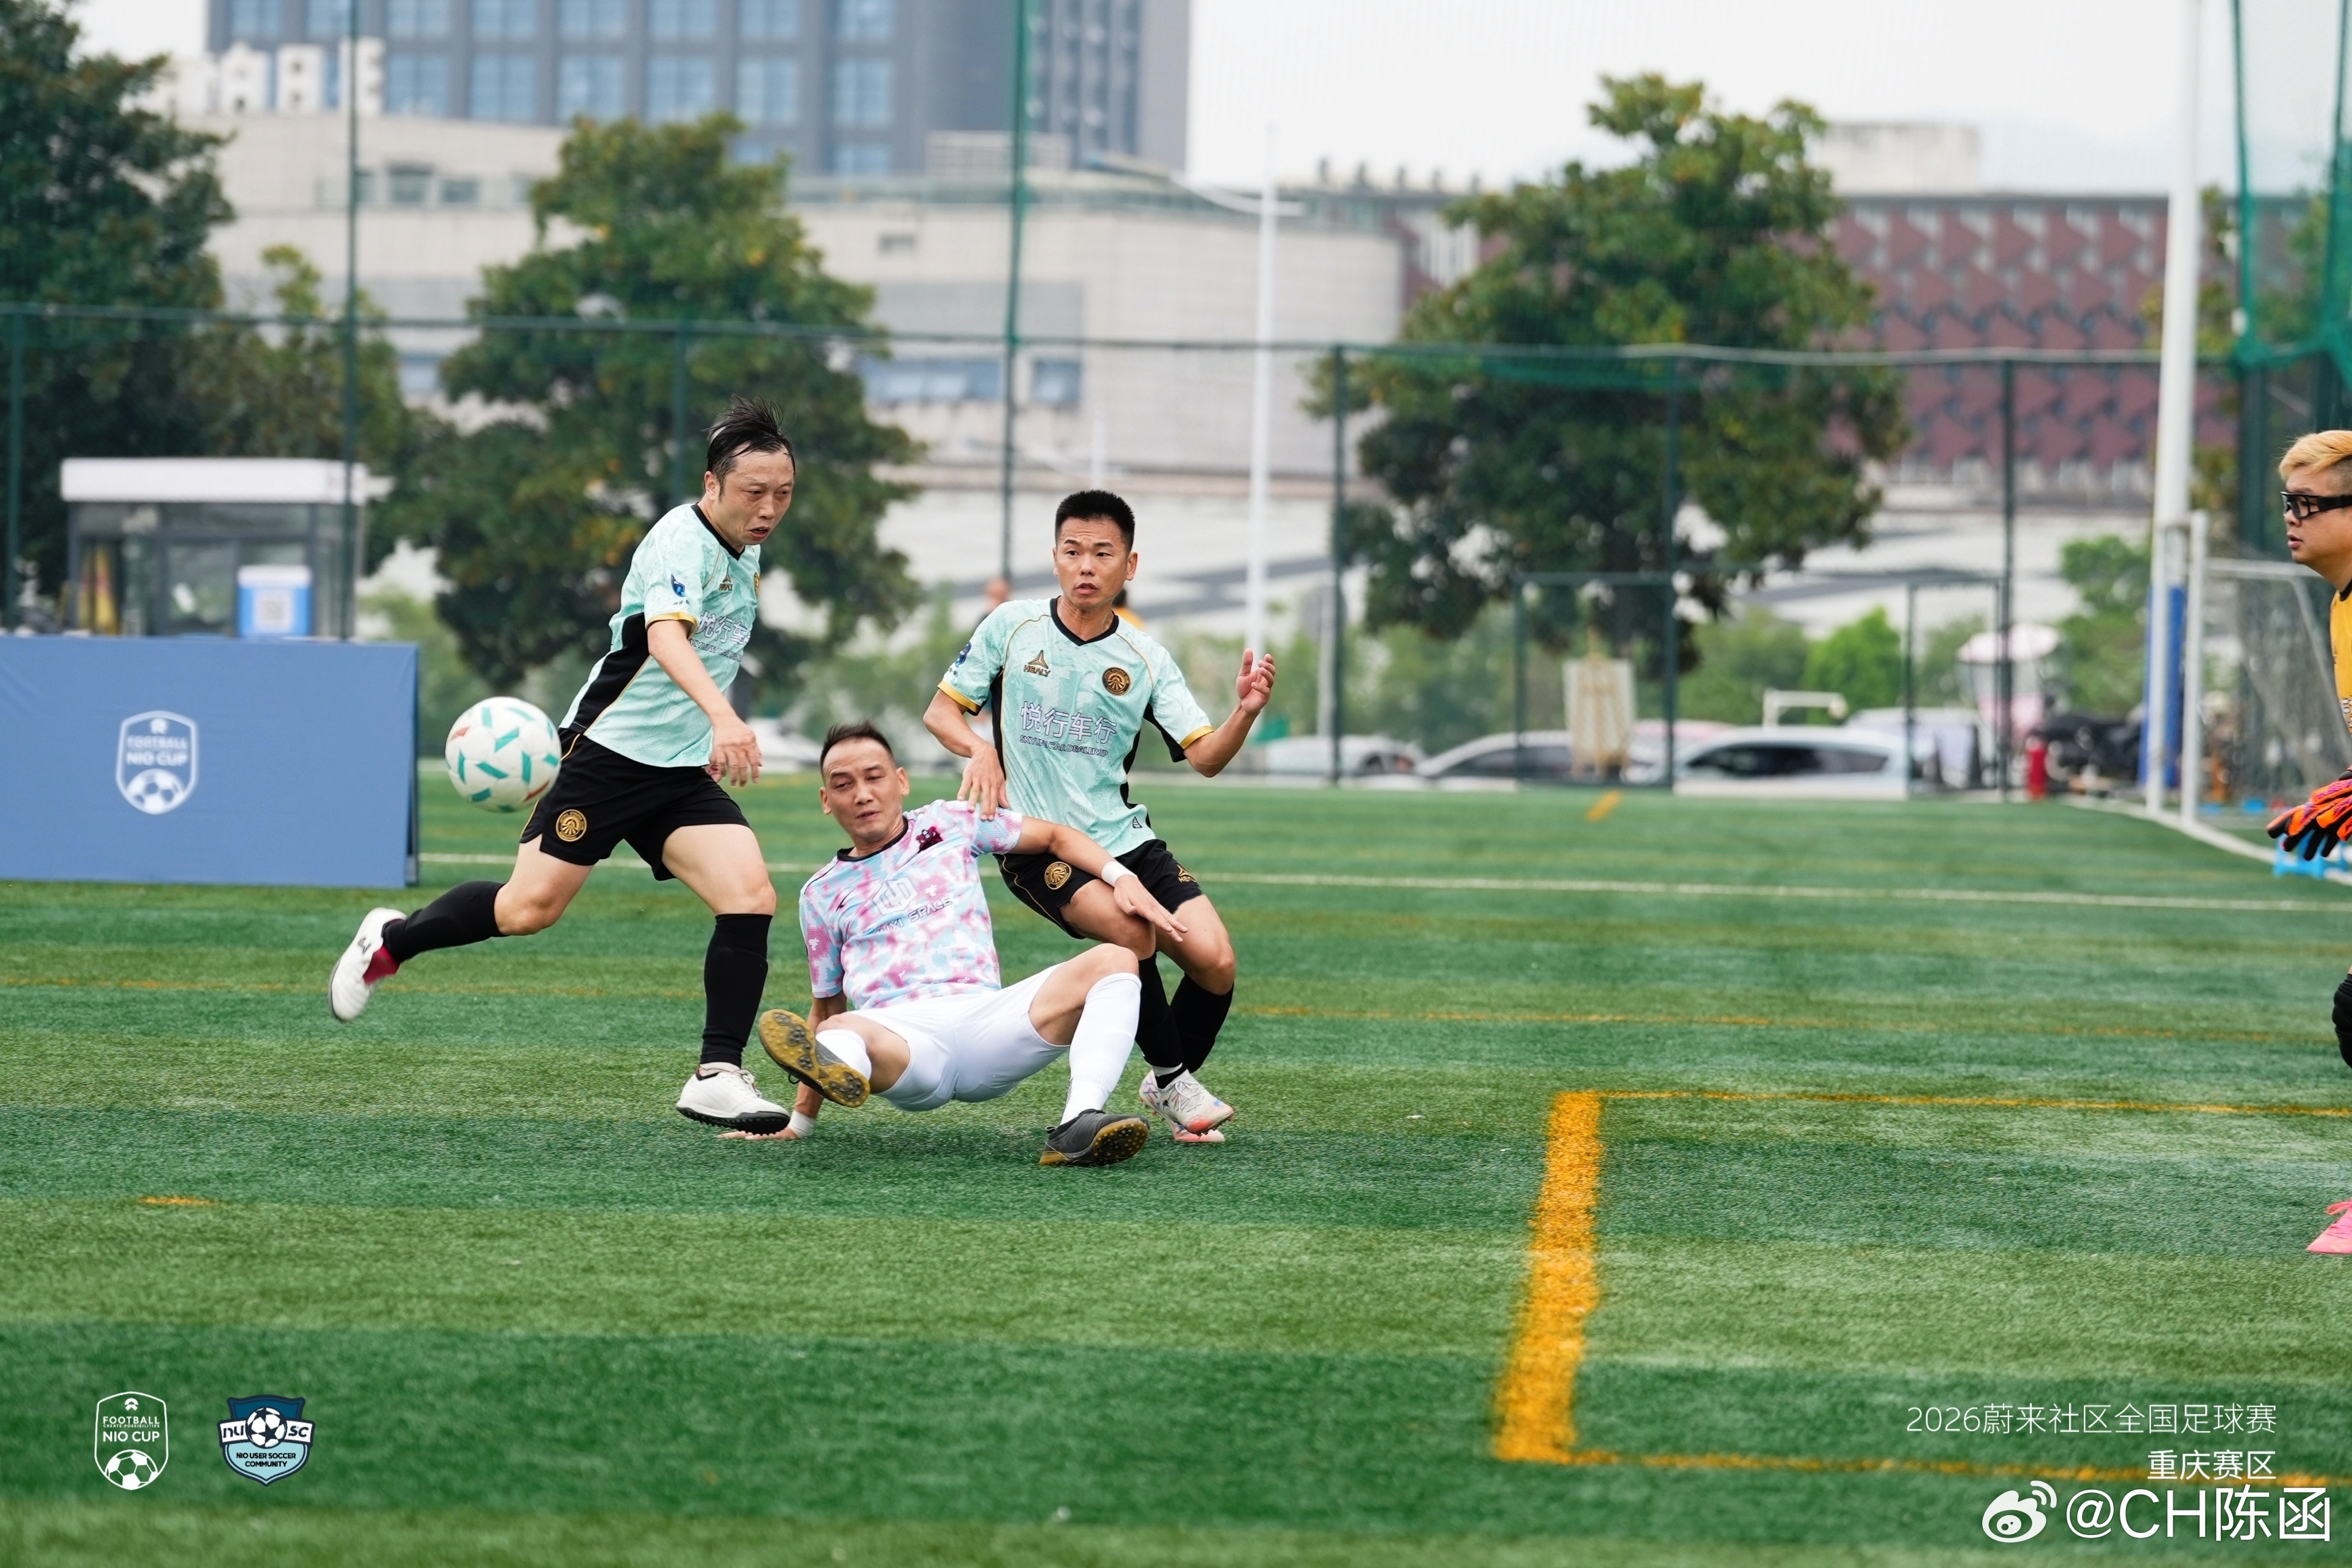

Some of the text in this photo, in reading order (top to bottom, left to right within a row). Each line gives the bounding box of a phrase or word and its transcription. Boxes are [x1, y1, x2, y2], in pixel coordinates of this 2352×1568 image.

[1023, 665, 1051, 677] HEALY
[1020, 701, 1117, 744] 悦行车行
[126, 751, 188, 767] NIO CUP
[907, 897, 953, 922] SPACE
